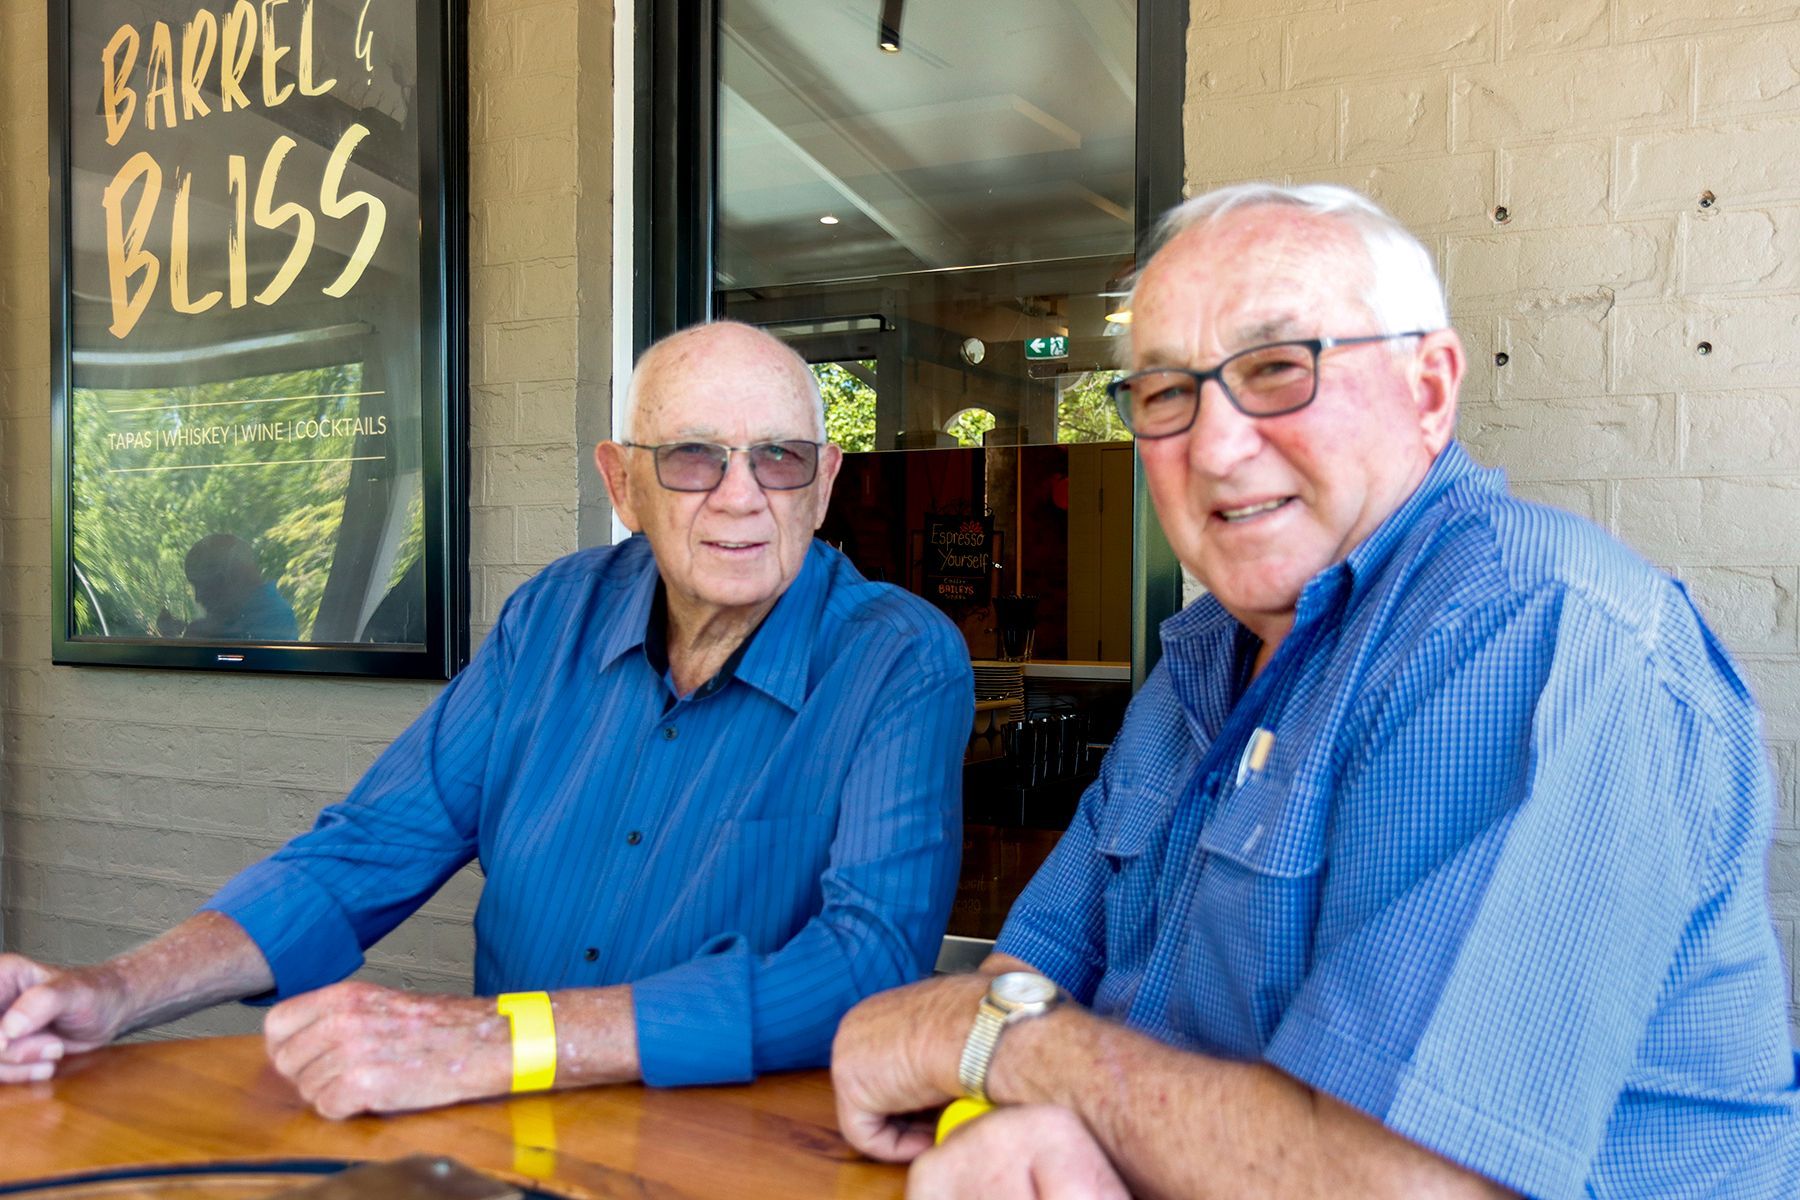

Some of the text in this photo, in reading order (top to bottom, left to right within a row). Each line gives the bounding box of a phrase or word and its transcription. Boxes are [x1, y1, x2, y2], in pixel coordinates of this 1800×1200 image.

[102, 0, 337, 146] BARREL
[102, 123, 387, 339] BLISS
[107, 415, 387, 450] TAPAS WHISKEY WINE COCKTAILS
[931, 523, 985, 551] Espresso
[937, 548, 989, 574] Yourself
